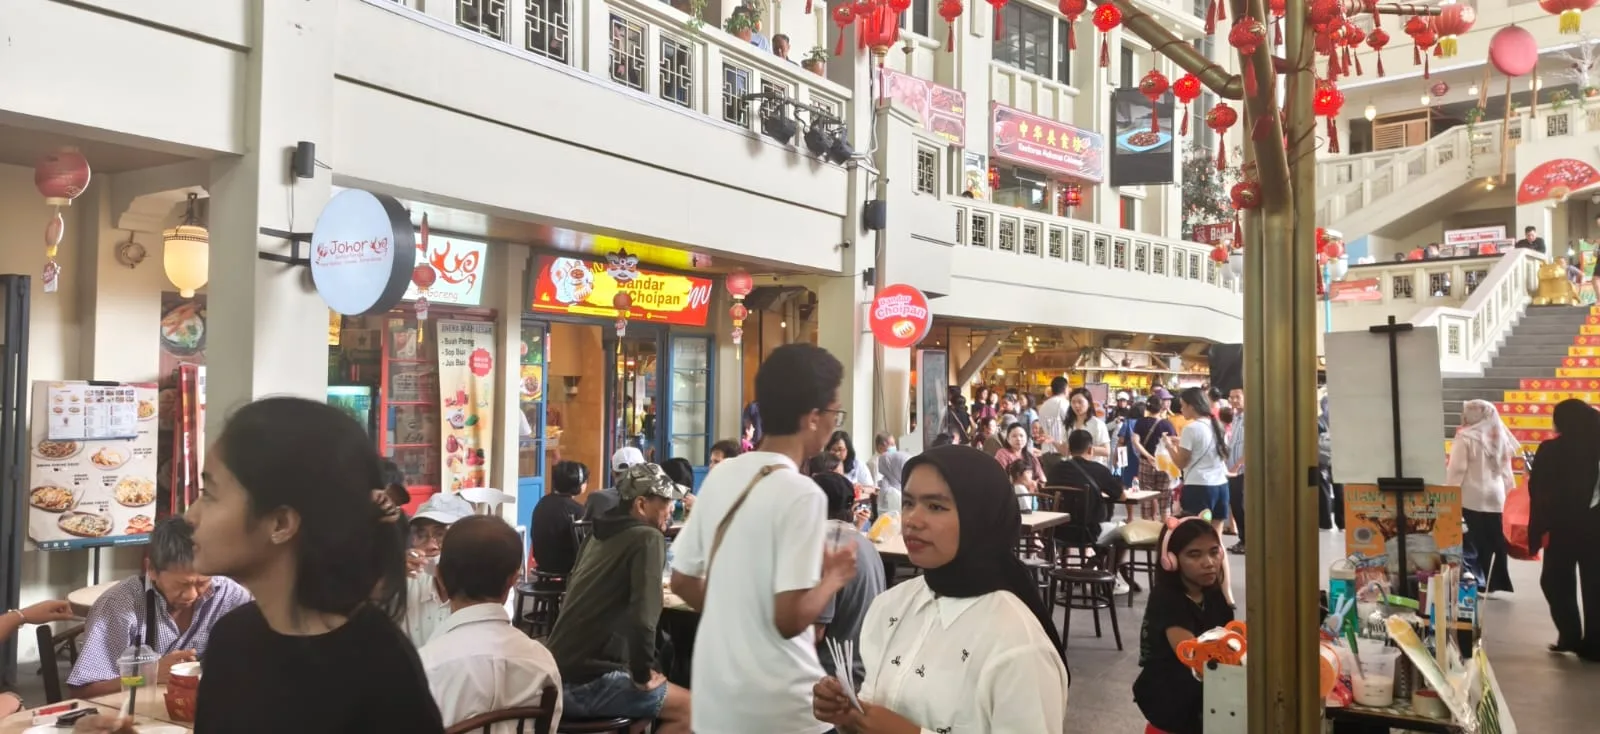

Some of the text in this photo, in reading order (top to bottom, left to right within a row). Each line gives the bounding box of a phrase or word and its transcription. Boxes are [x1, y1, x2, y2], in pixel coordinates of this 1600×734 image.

[330, 240, 368, 255] Johor
[629, 290, 680, 308] Choipan
[879, 294, 912, 306] Bandar
[876, 304, 925, 318] Choipan
